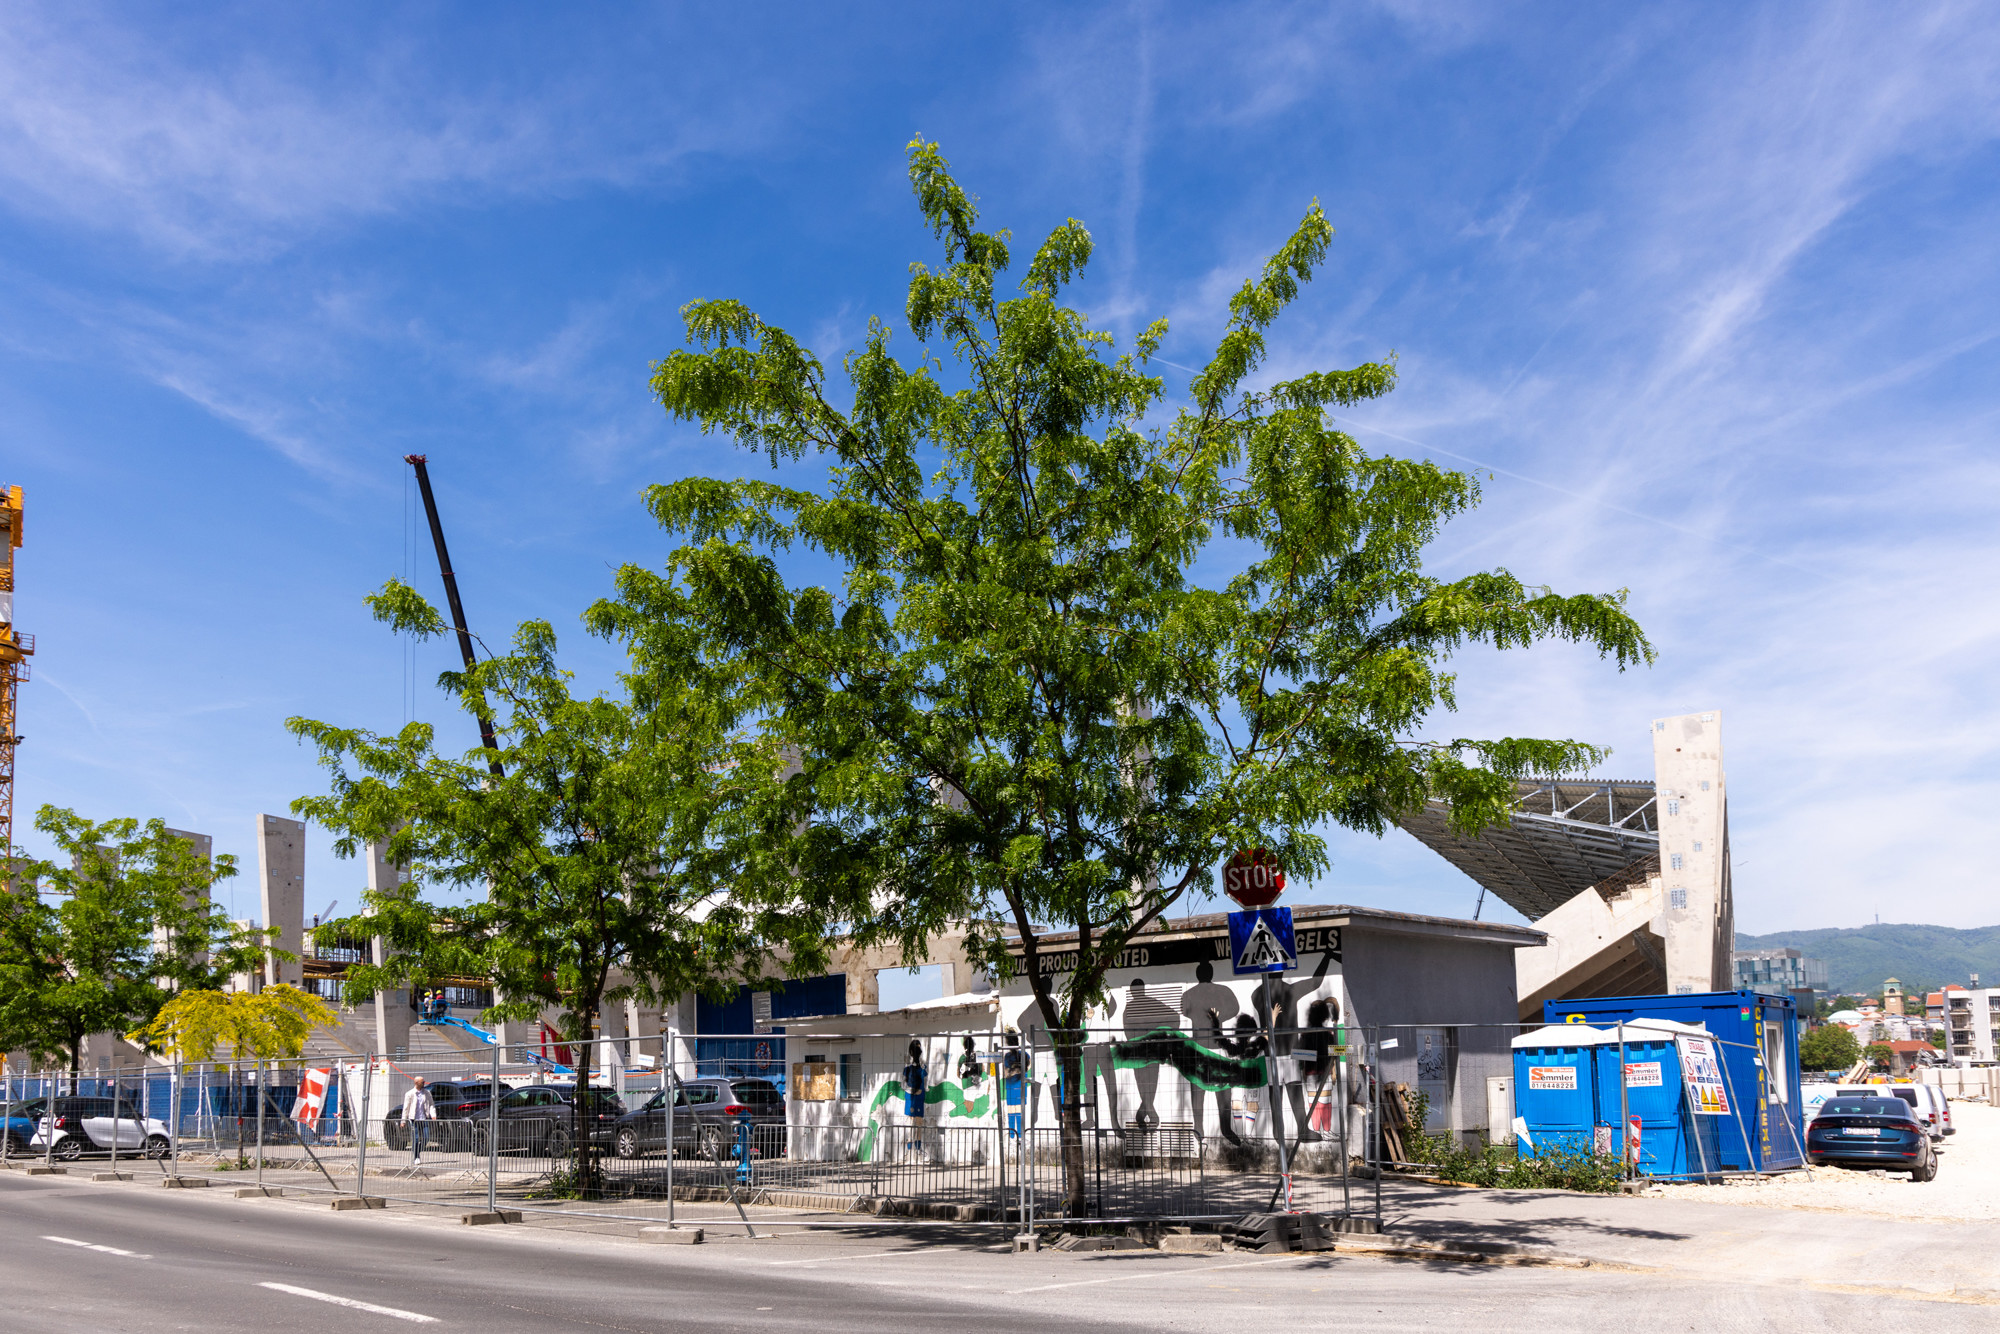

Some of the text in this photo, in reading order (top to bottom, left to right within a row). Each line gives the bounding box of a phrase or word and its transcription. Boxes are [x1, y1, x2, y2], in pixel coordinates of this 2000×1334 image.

[1228, 864, 1281, 891] STOP
[1295, 929, 1339, 953] GELS
[1039, 952, 1079, 973] PROUD
[1531, 1067, 1574, 1081] Semmler
[1625, 1064, 1659, 1075] Semmler
